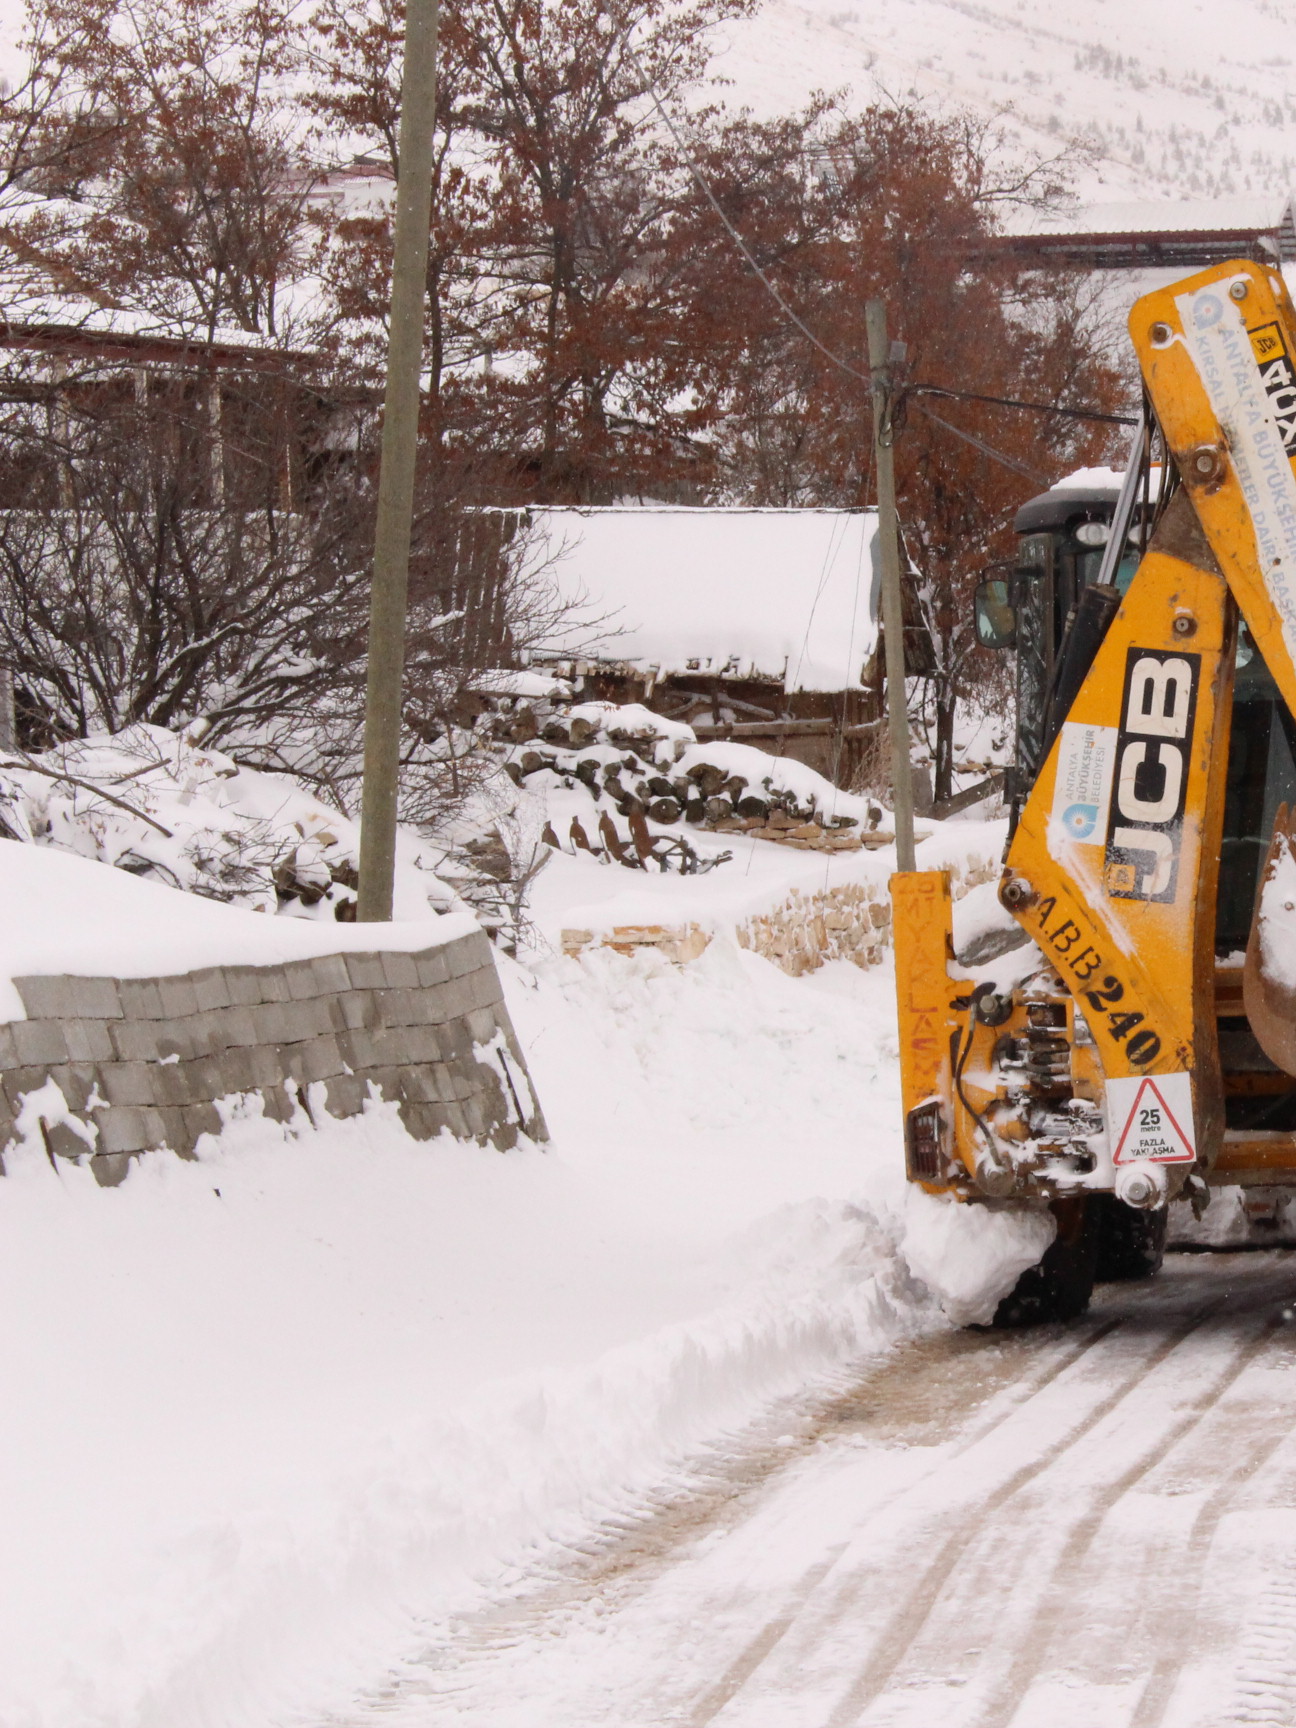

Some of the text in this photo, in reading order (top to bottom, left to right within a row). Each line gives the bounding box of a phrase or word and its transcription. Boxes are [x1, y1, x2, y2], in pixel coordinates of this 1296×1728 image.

[1196, 335, 1225, 399] KIRSAL
[1256, 336, 1277, 354] JCB
[1218, 328, 1261, 427] ANTALYA
[1065, 751, 1079, 801] ANTALYA
[1077, 729, 1096, 802] BÜYÜKŞEHİR
[1091, 747, 1106, 803] BELEDİYESİ
[1113, 656, 1193, 895] JCB
[1086, 975, 1162, 1066] 240
[1140, 1109, 1161, 1126] 25
[1140, 1138, 1166, 1148] FAZLA
[1141, 1125, 1161, 1133] metre
